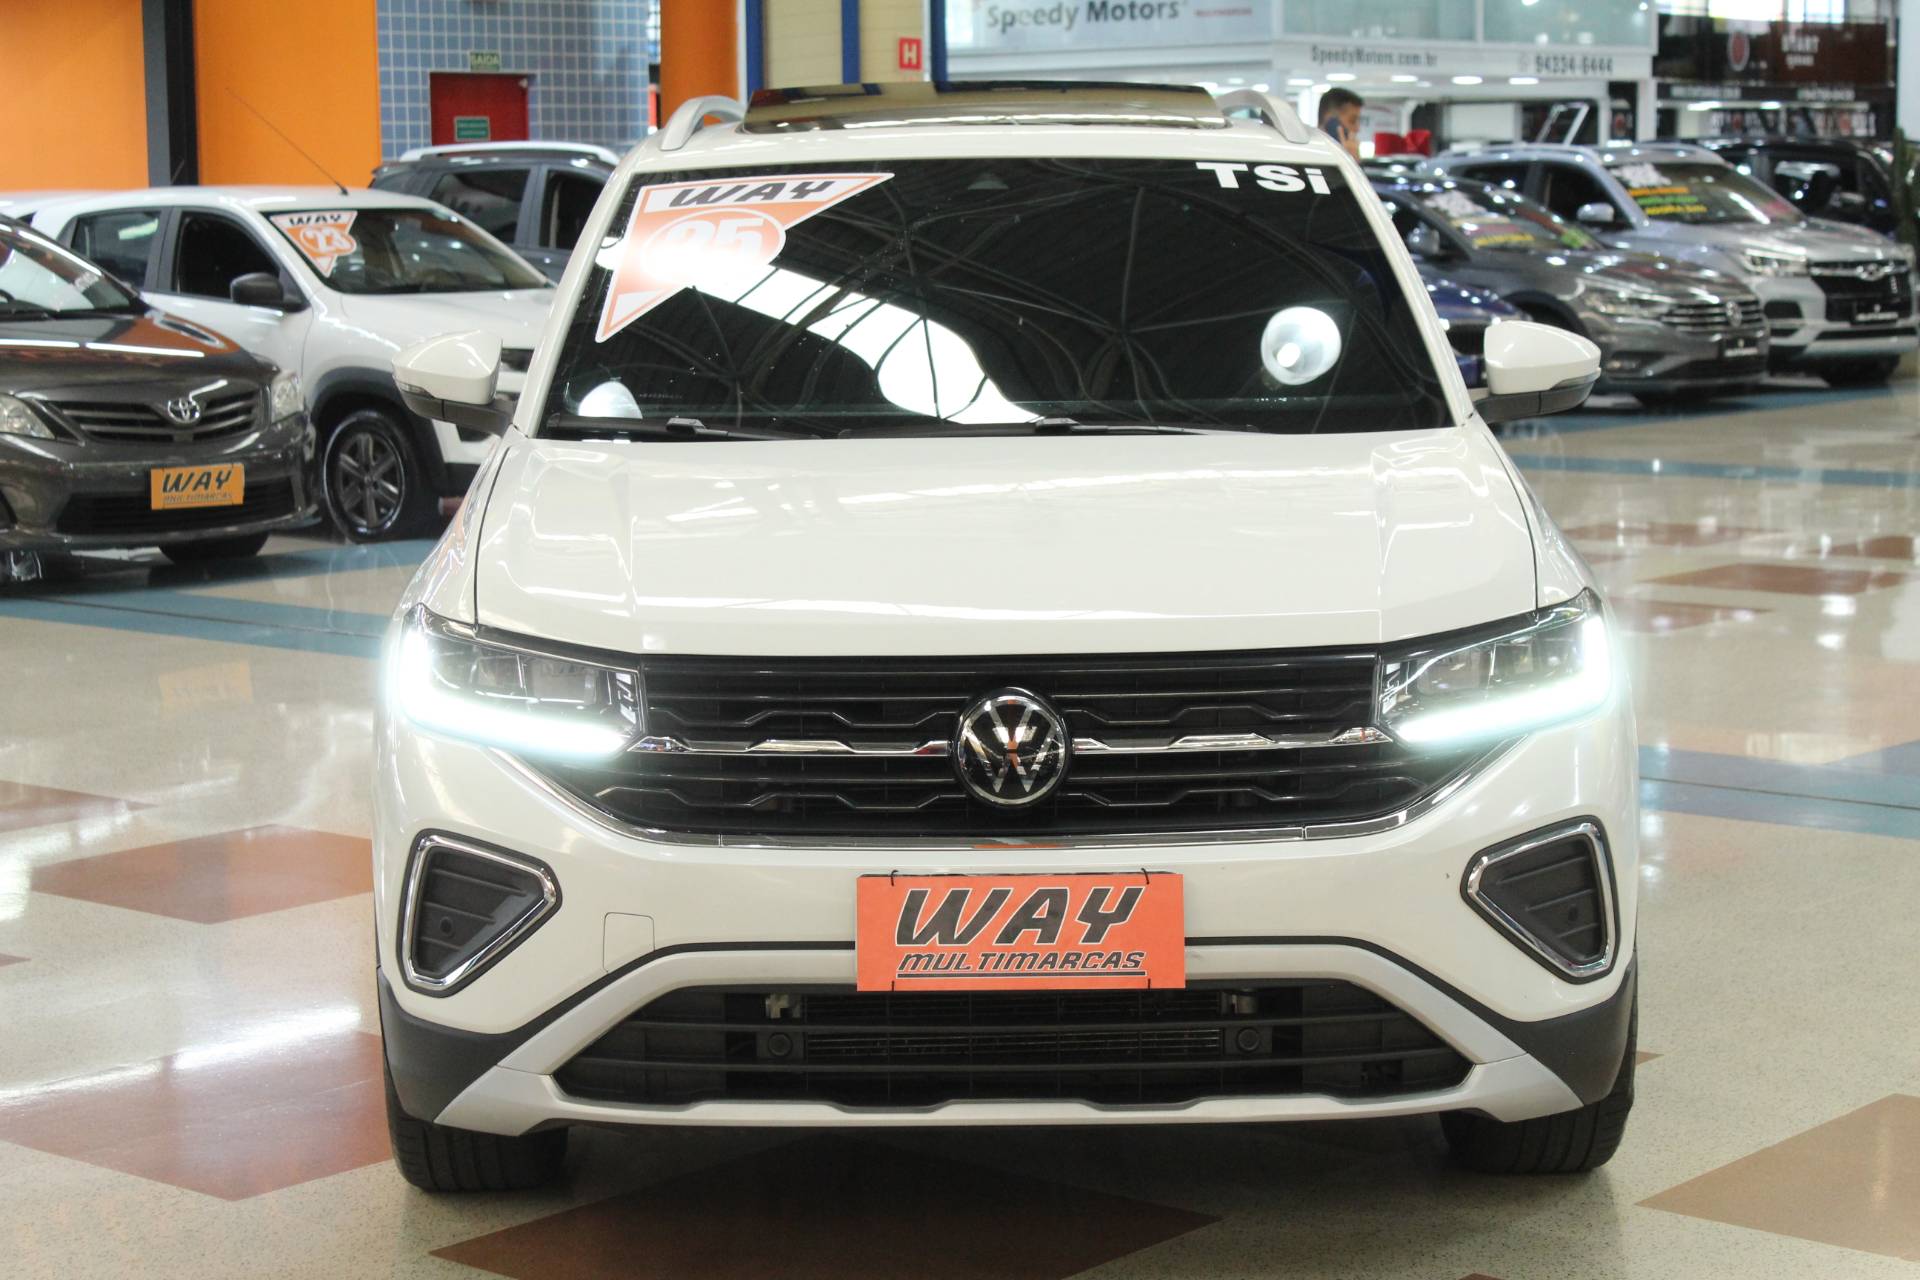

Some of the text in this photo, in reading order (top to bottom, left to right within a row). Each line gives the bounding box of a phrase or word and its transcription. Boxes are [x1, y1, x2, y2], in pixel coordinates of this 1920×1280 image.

[987, 0, 1180, 35] Speedy Motors
[903, 42, 917, 66] H
[669, 180, 835, 208] WAY
[163, 470, 233, 493] WAY
[895, 886, 1146, 947] WAY
[897, 950, 1146, 972] MULTIMARCAS
